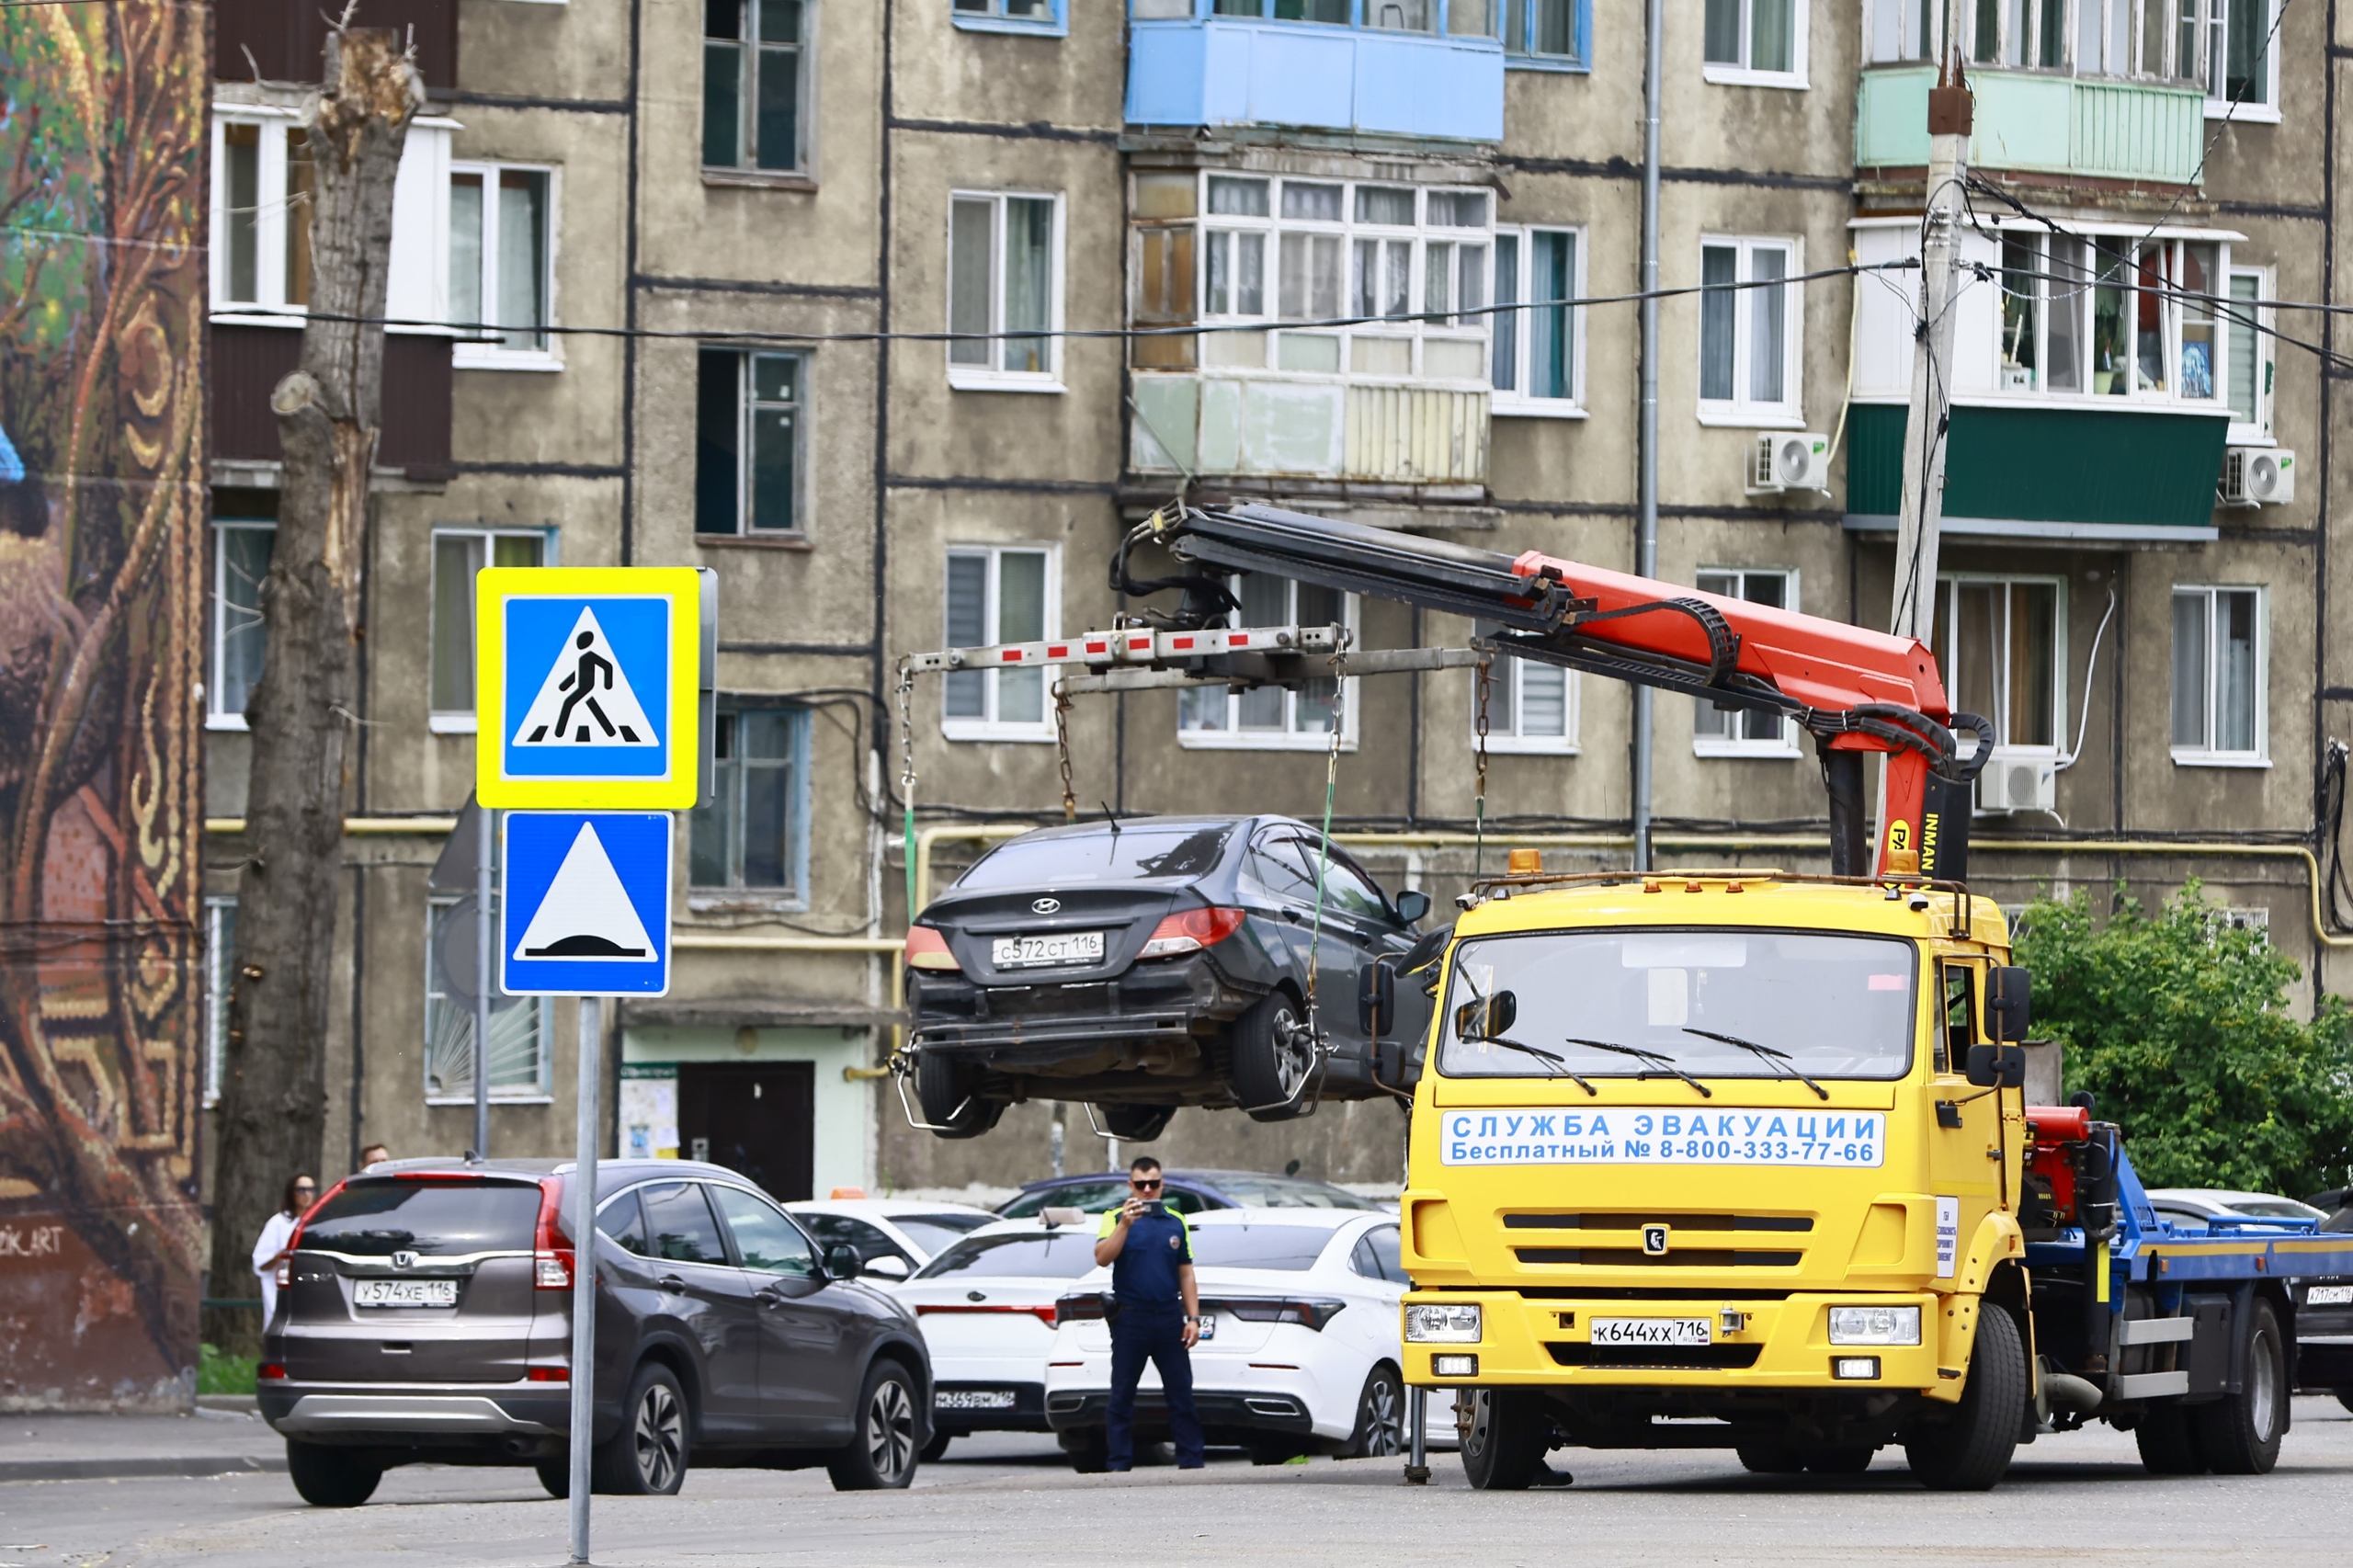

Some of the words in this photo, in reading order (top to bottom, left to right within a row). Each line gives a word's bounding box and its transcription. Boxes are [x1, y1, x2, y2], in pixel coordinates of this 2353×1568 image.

[1922, 813, 1938, 870] INMAN
[1001, 940, 1068, 960] С572СТ
[1072, 936, 1097, 949] 116
[1452, 1116, 1610, 1138] СЛУЖБА
[1633, 1115, 1876, 1142] ЭВАКУАЦИИ
[1451, 1141, 1615, 1160] Бесплатный
[1624, 1141, 1651, 1158] №
[1659, 1140, 1874, 1162] 8-800-333-77-66
[361, 1282, 423, 1301] У574ХЕ
[427, 1283, 450, 1297] 116
[1597, 1323, 1672, 1342] К644ХХ
[1676, 1322, 1705, 1336] 716
